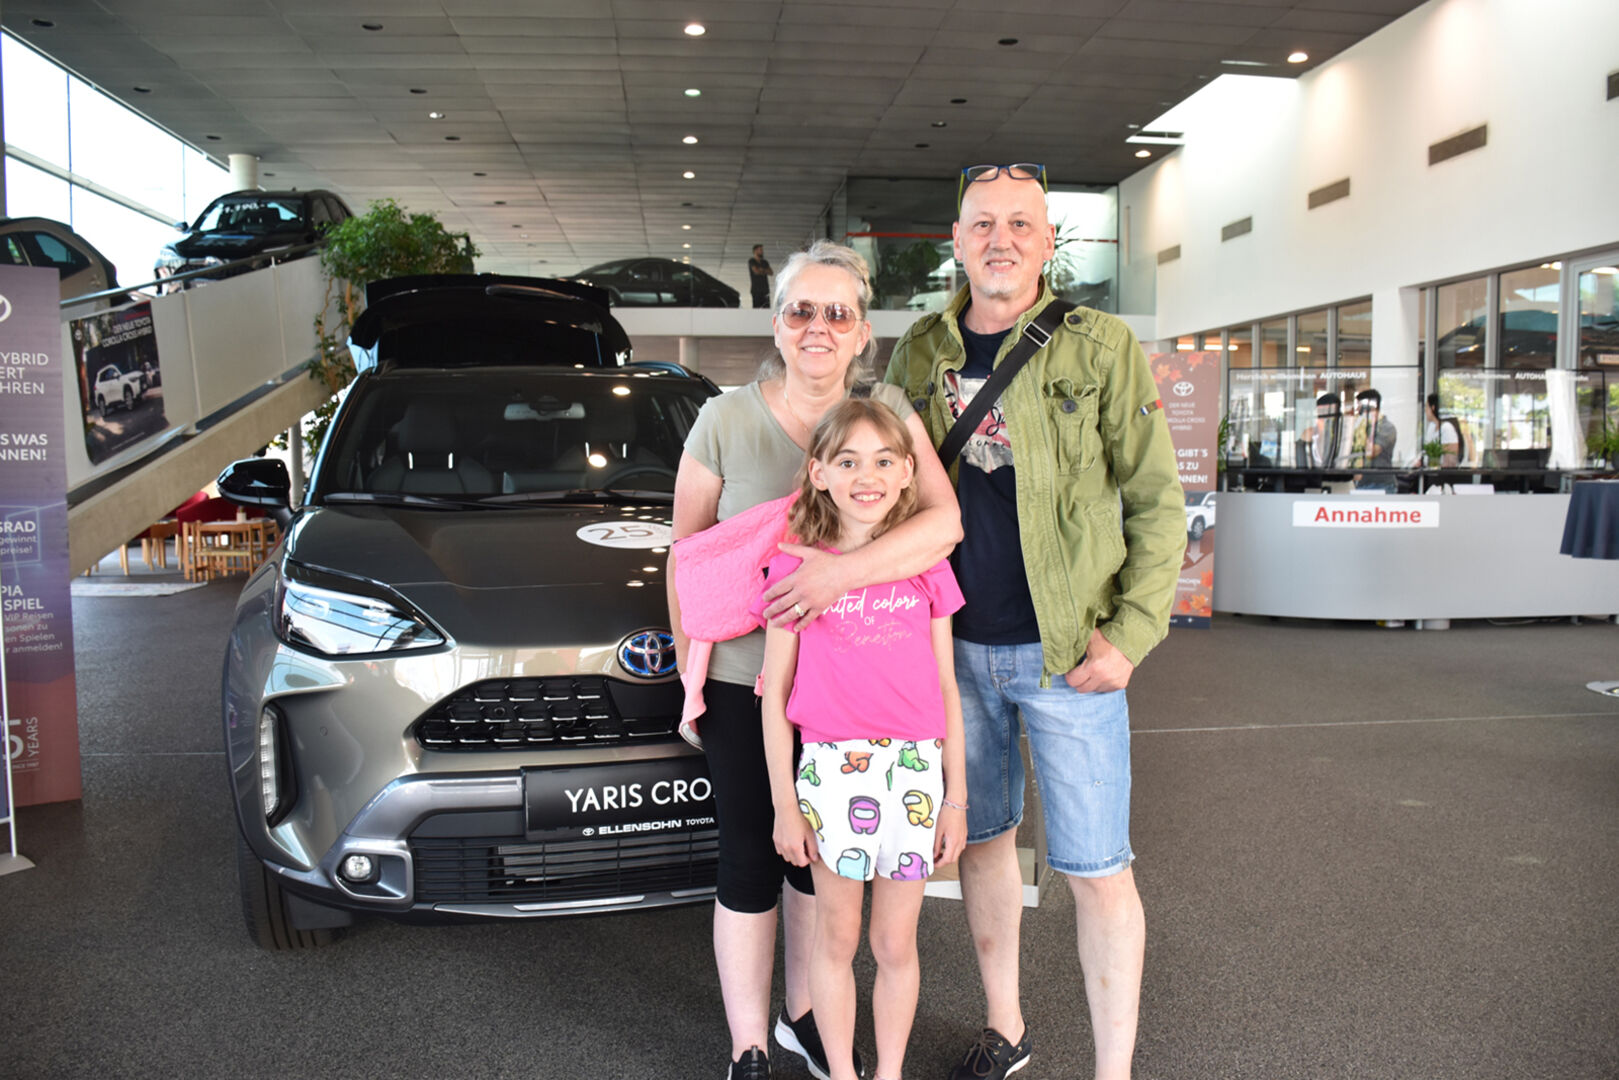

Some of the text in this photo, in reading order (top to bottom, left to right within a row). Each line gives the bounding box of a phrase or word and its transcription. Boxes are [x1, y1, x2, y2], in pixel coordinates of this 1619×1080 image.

[0, 352, 49, 366] YBRID
[1320, 371, 1367, 380] AUTOHAUS
[0, 381, 45, 394] HREN
[11, 433, 48, 446] WAS
[0, 448, 47, 461] NNEN!
[1177, 448, 1198, 458] GIBT
[1186, 461, 1199, 470] ZU
[1314, 506, 1421, 523] Annahme
[587, 525, 654, 540] 25
[1, 584, 24, 597] PIA
[4, 597, 45, 611] SPIEL
[872, 586, 920, 613] colors
[37, 623, 49, 631] zu
[25, 716, 40, 758] YEARS
[564, 777, 715, 813] YARIS CRO
[598, 817, 715, 835] ELLENSOHN TOYOTA
